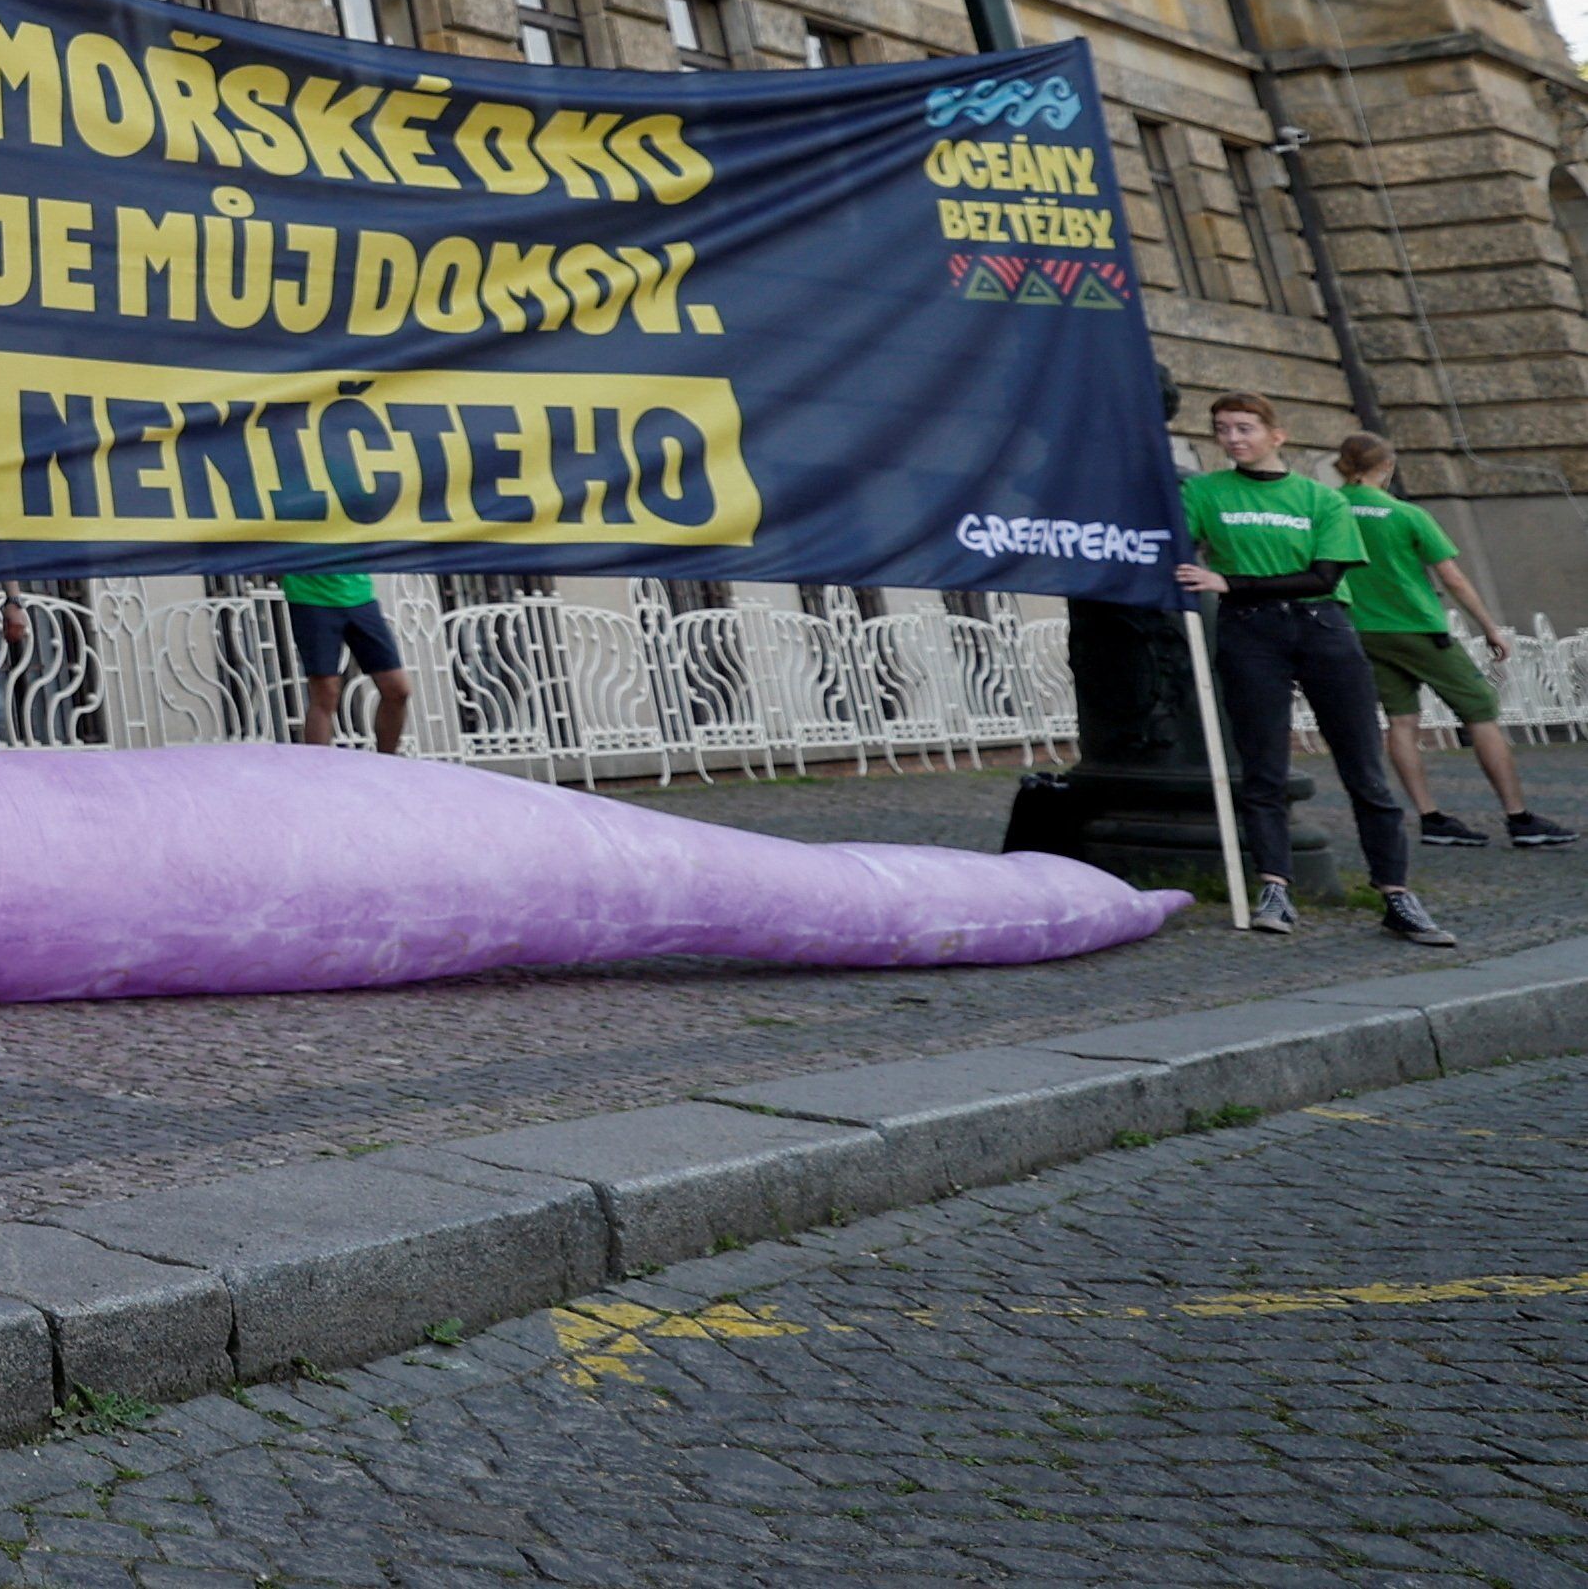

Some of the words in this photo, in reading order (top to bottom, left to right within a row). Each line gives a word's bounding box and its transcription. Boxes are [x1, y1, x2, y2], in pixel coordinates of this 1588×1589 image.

[454, 101, 714, 205] DNO
[924, 134, 1099, 196] OCEÁNY
[117, 185, 337, 333] MŮJ
[347, 229, 725, 337] DOMOV.
[937, 199, 1010, 243] BEZ
[1003, 196, 1116, 250] TĚŽBY
[19, 379, 536, 524] NENIČTE
[544, 405, 718, 528] HO
[956, 513, 1171, 564] GREENPEACE
